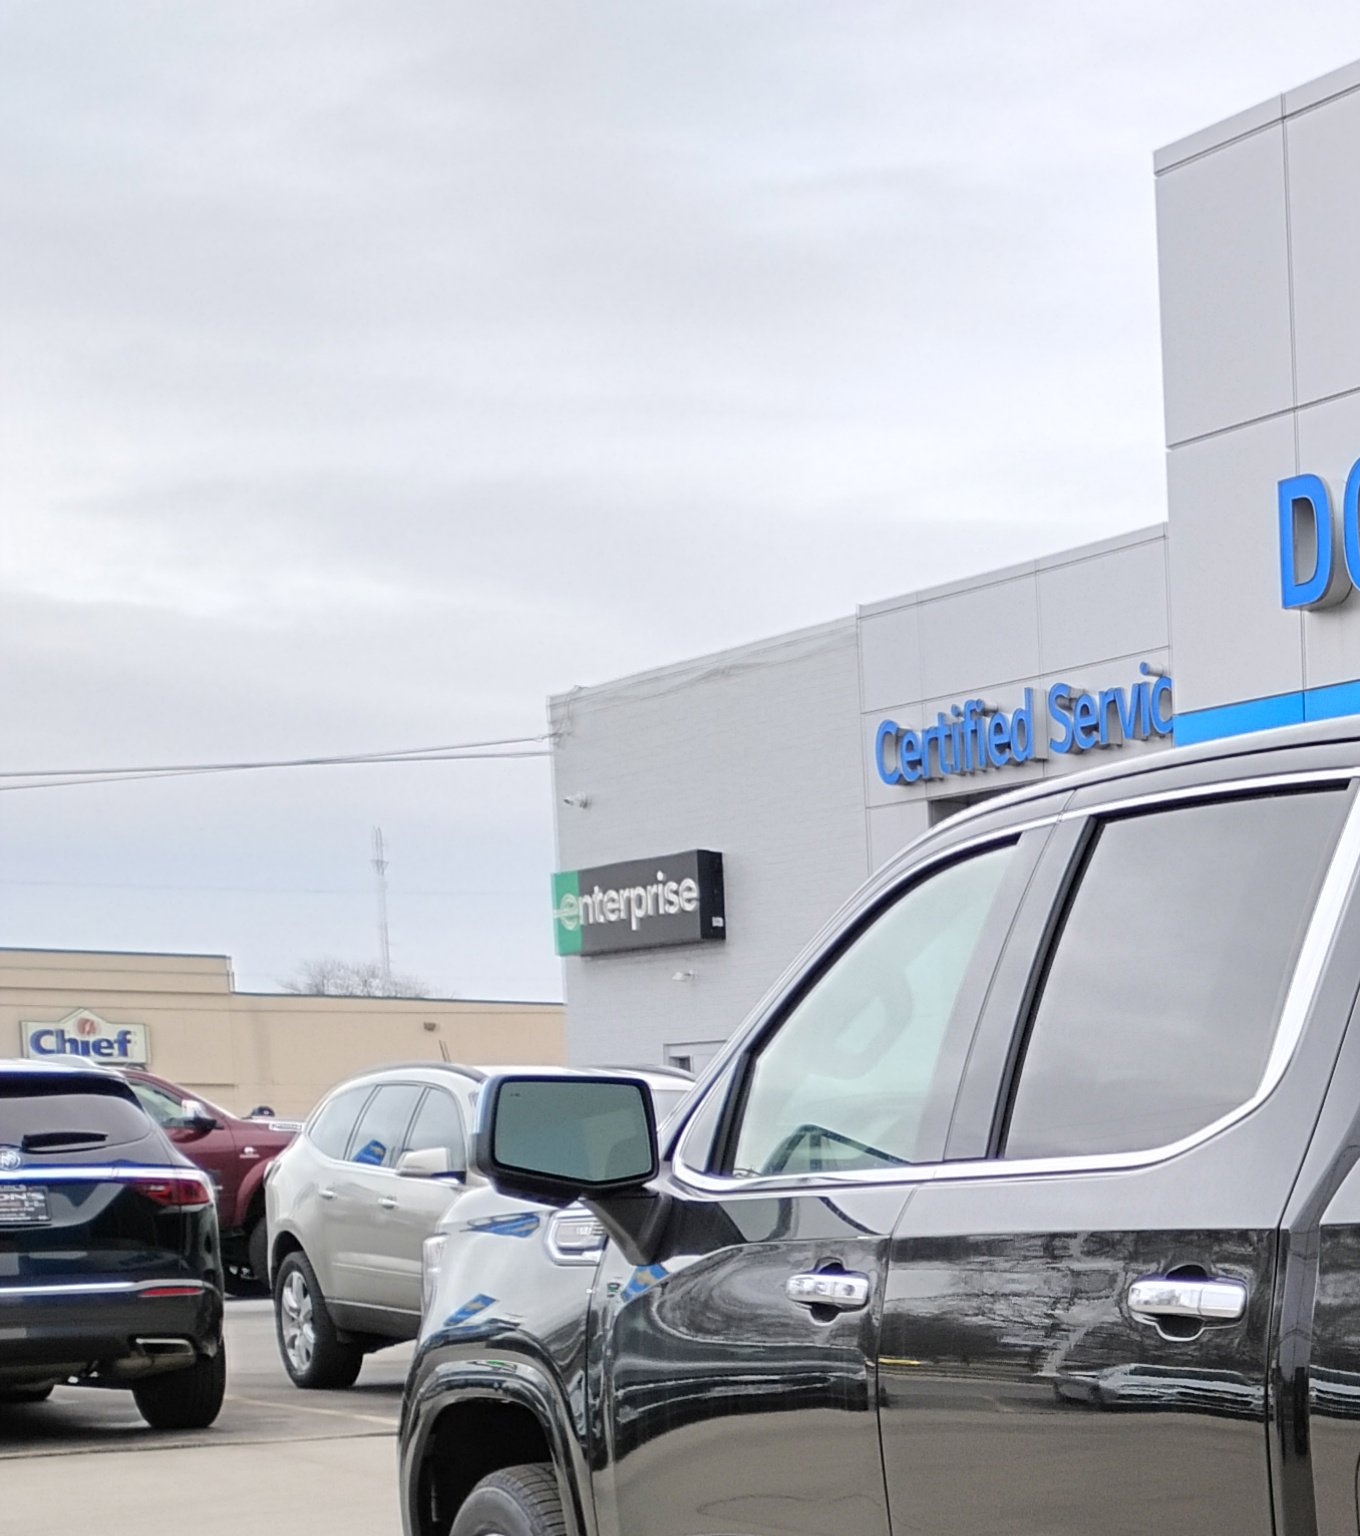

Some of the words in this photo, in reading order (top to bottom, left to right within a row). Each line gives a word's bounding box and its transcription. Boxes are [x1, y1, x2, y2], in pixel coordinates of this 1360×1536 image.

[876, 687, 1036, 786] Certified
[1049, 661, 1174, 753] Servic
[554, 869, 698, 931] enterprise
[30, 1028, 132, 1057] Chief
